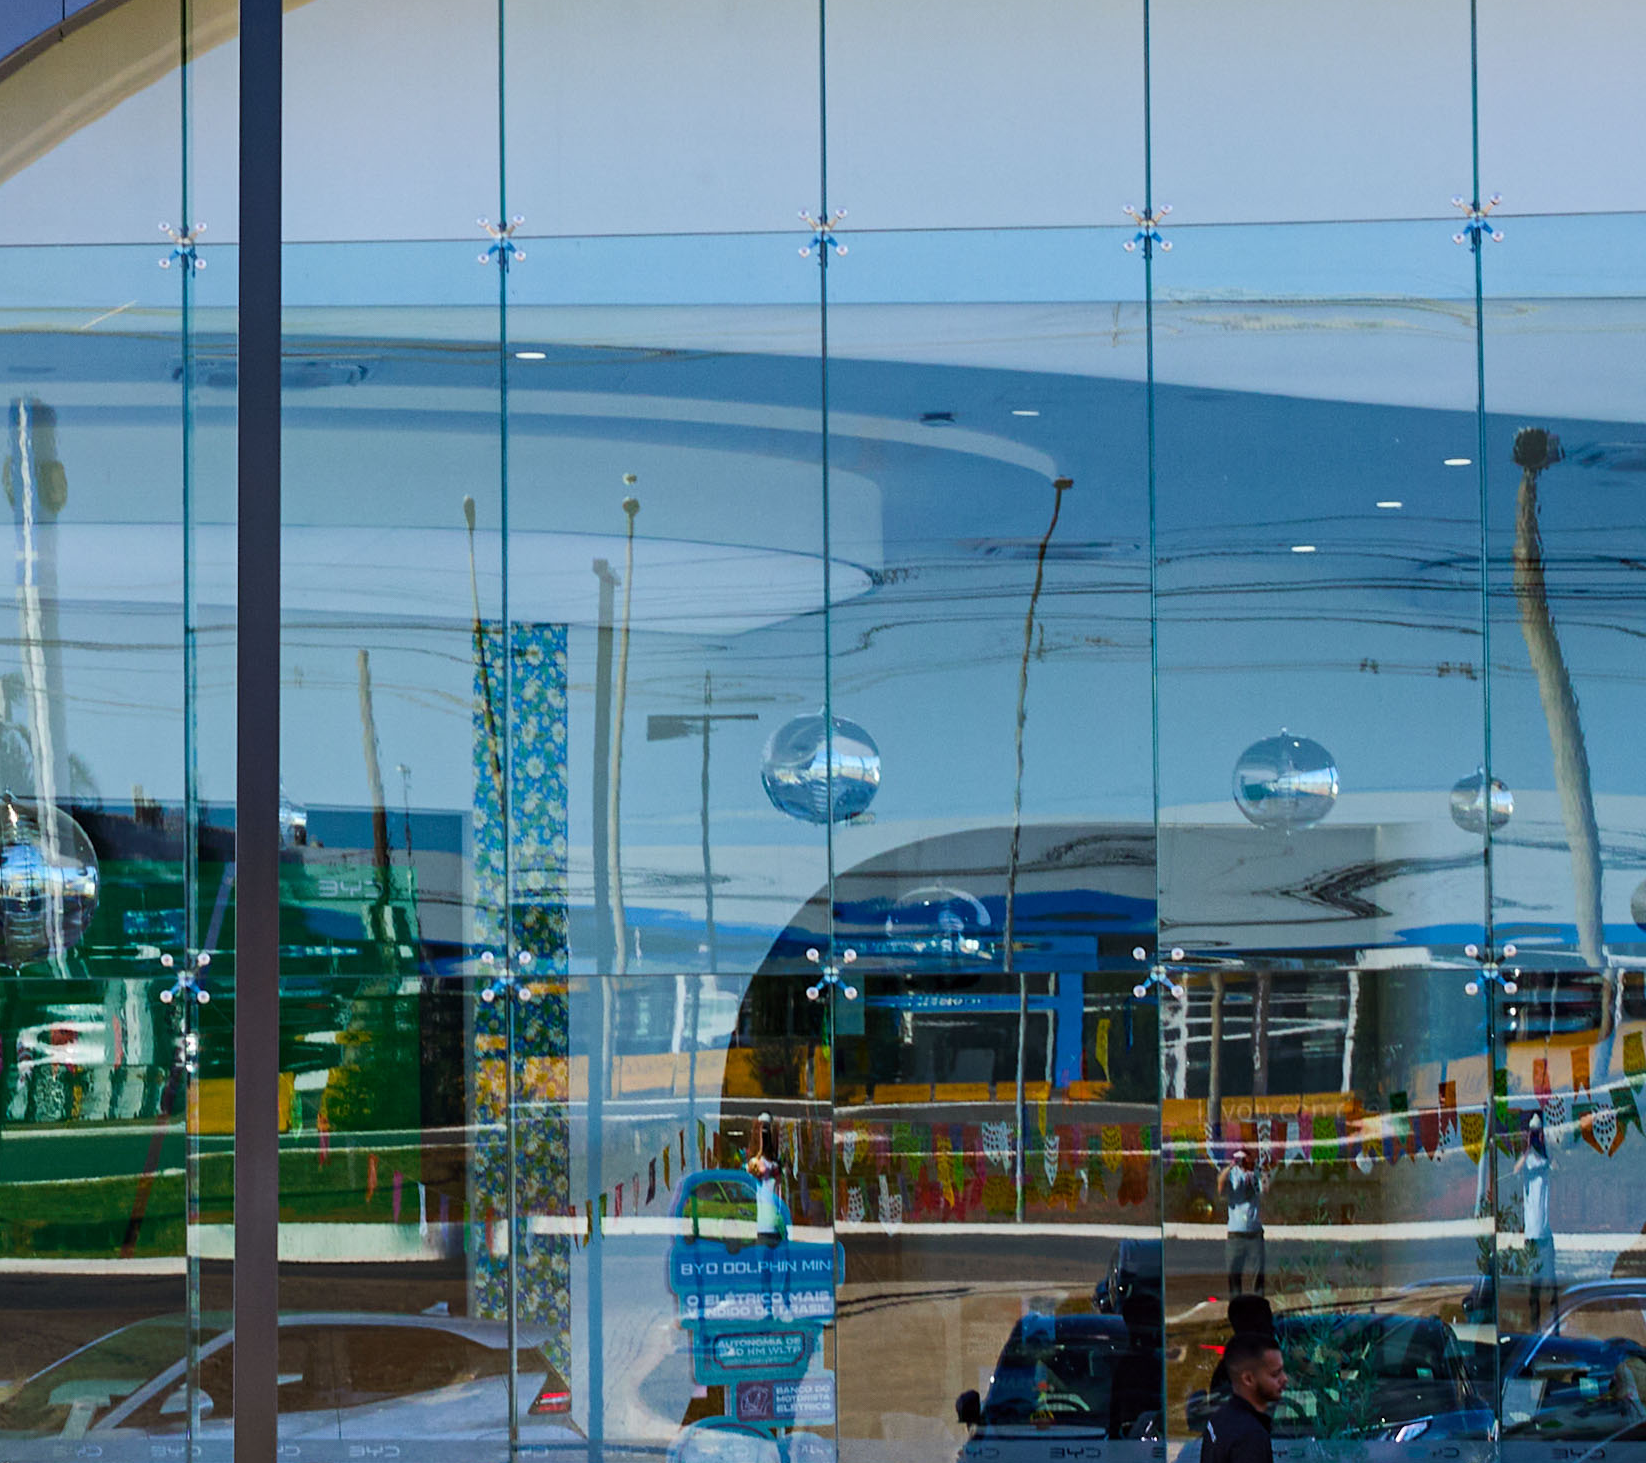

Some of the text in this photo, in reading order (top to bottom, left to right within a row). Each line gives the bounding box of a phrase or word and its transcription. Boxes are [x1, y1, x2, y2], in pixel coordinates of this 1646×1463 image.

[681, 1259, 834, 1276] BYD DOLPHIN MIN
[687, 1295, 699, 1306] O
[789, 1290, 830, 1303] MAIS
[348, 1445, 400, 1458] BYD
[1050, 1447, 1101, 1459] BYD
[1552, 1448, 1606, 1460] BYD
